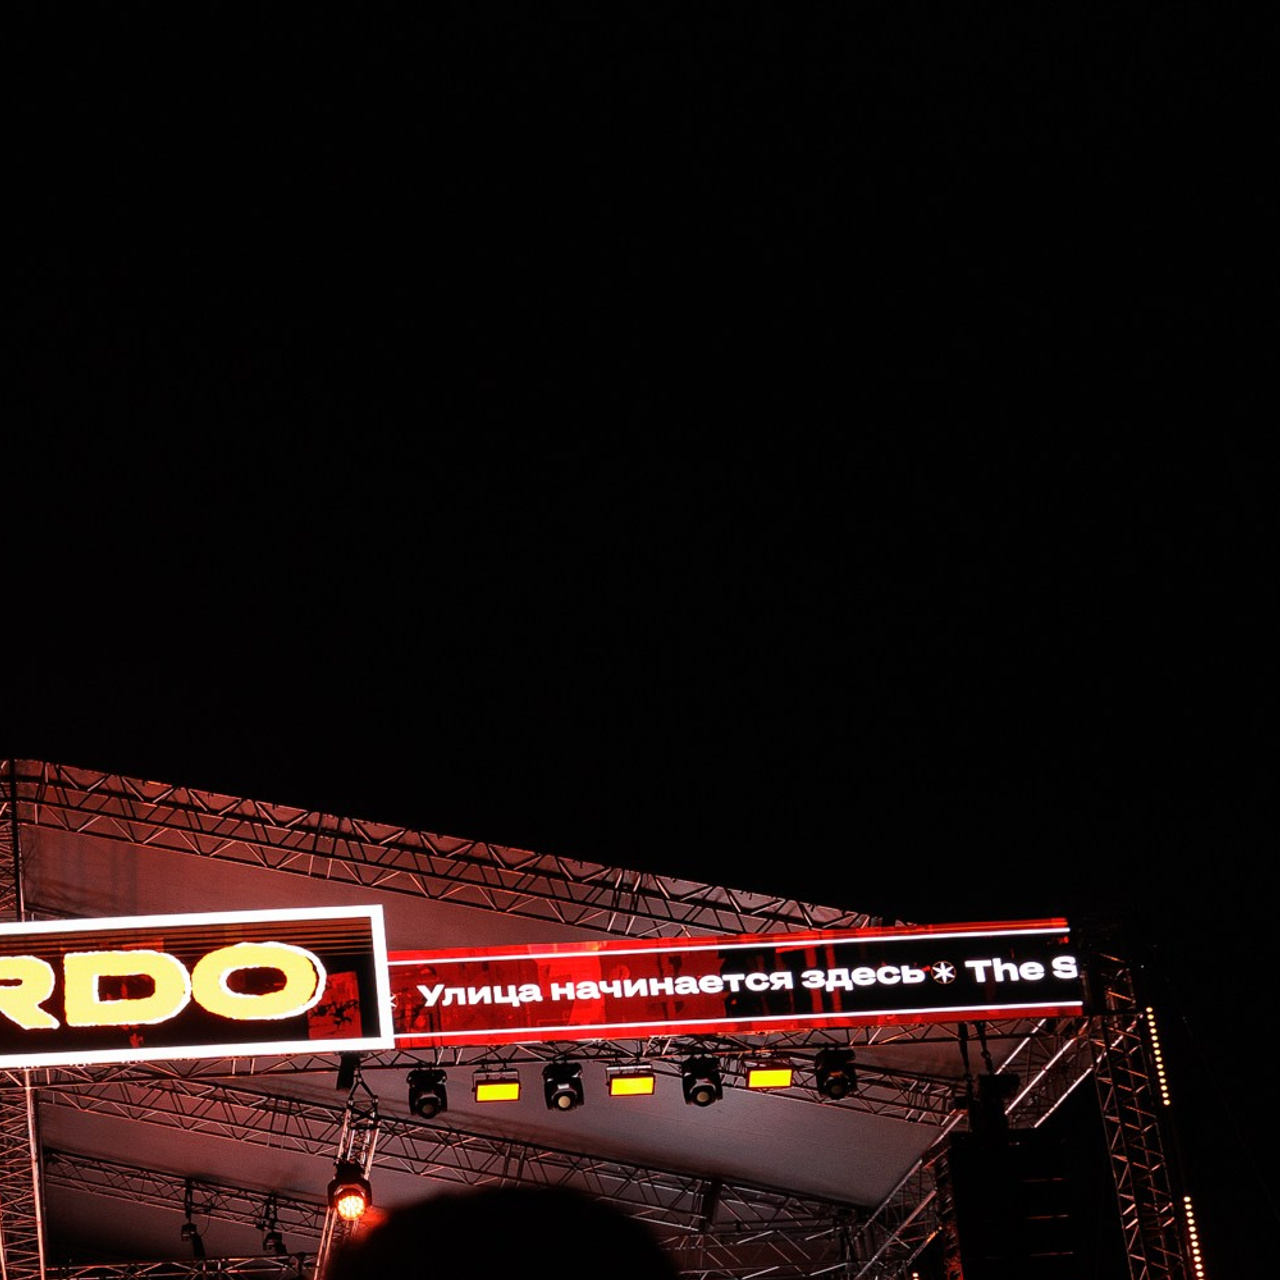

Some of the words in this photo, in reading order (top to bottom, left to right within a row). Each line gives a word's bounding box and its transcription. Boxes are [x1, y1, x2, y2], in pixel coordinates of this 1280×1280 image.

[416, 983, 543, 1007] Улица
[550, 971, 794, 1001] начинается
[801, 965, 926, 992] здесь
[964, 957, 1045, 983] The
